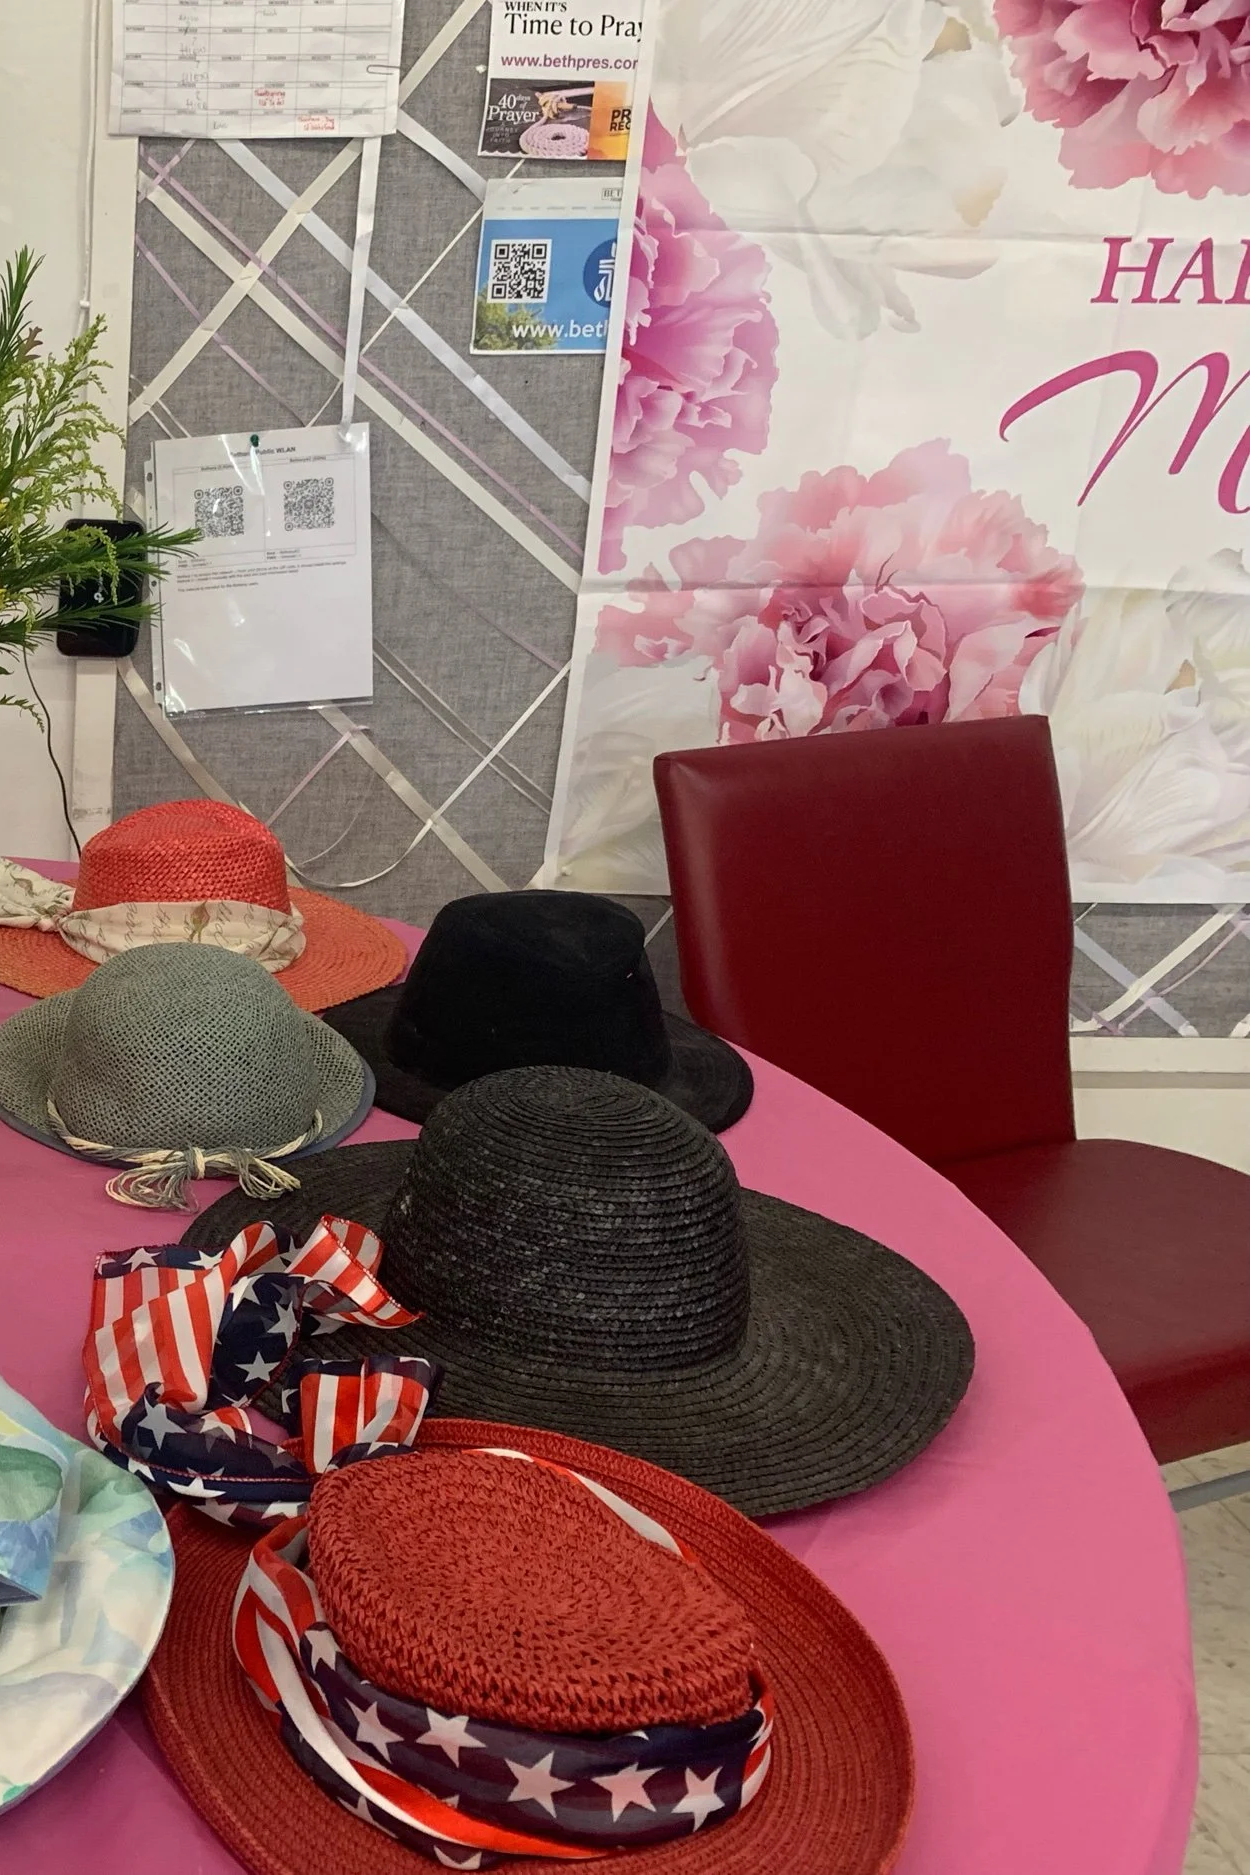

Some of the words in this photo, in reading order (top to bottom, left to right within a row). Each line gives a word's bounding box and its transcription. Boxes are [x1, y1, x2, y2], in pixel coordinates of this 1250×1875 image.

[504, 1, 543, 12] WHEN
[545, 2, 567, 12] IT'S
[504, 13, 563, 35] Time
[569, 18, 593, 36] to
[498, 94, 517, 109] 40
[487, 105, 540, 125] Prayer
